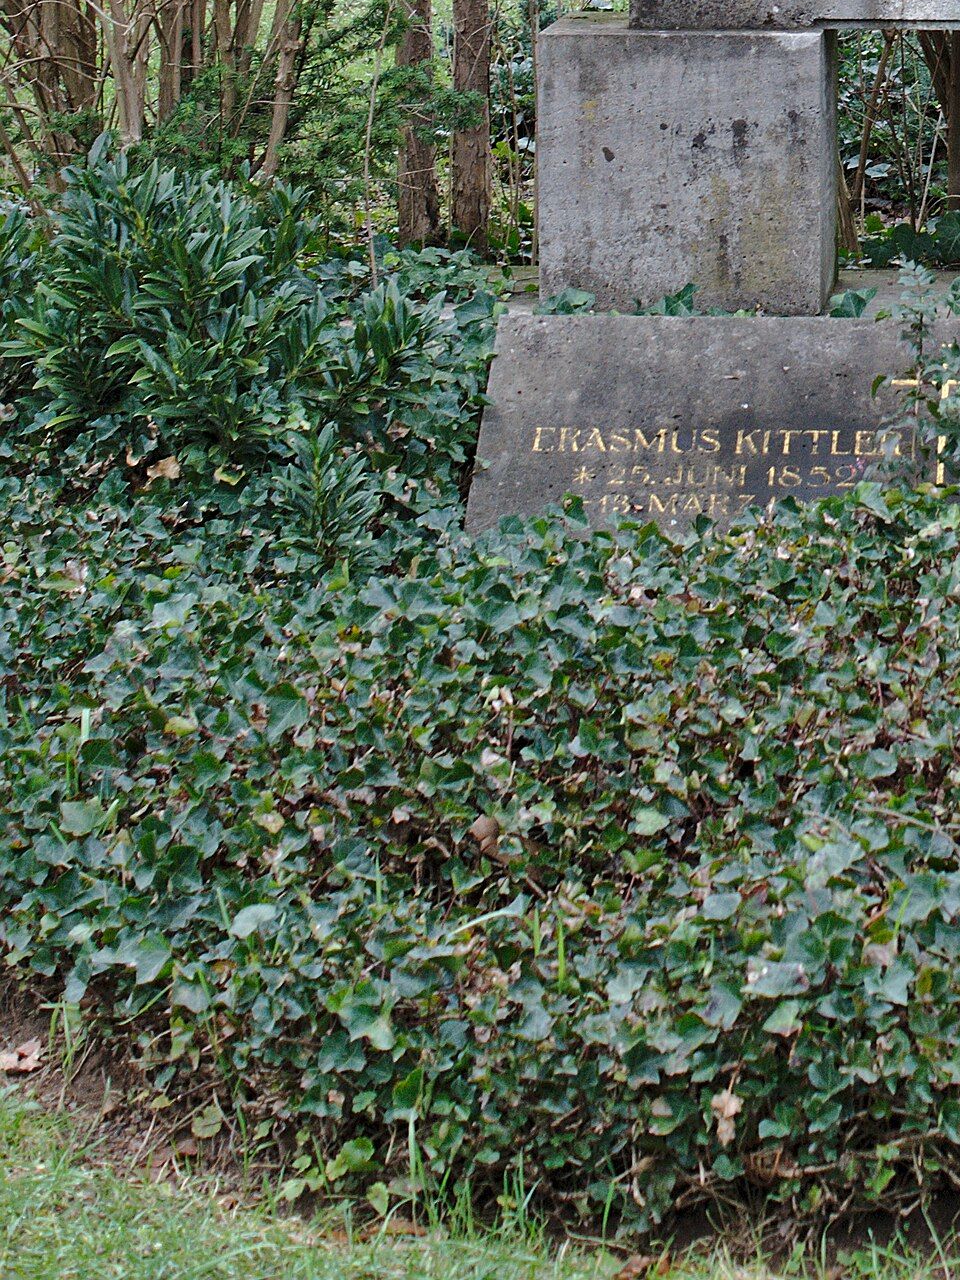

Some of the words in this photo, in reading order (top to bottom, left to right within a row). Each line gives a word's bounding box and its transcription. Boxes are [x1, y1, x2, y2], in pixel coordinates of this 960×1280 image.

[734, 429, 902, 456] KITTLER
[665, 464, 747, 488] JUNI
[766, 466, 858, 488] 1852
